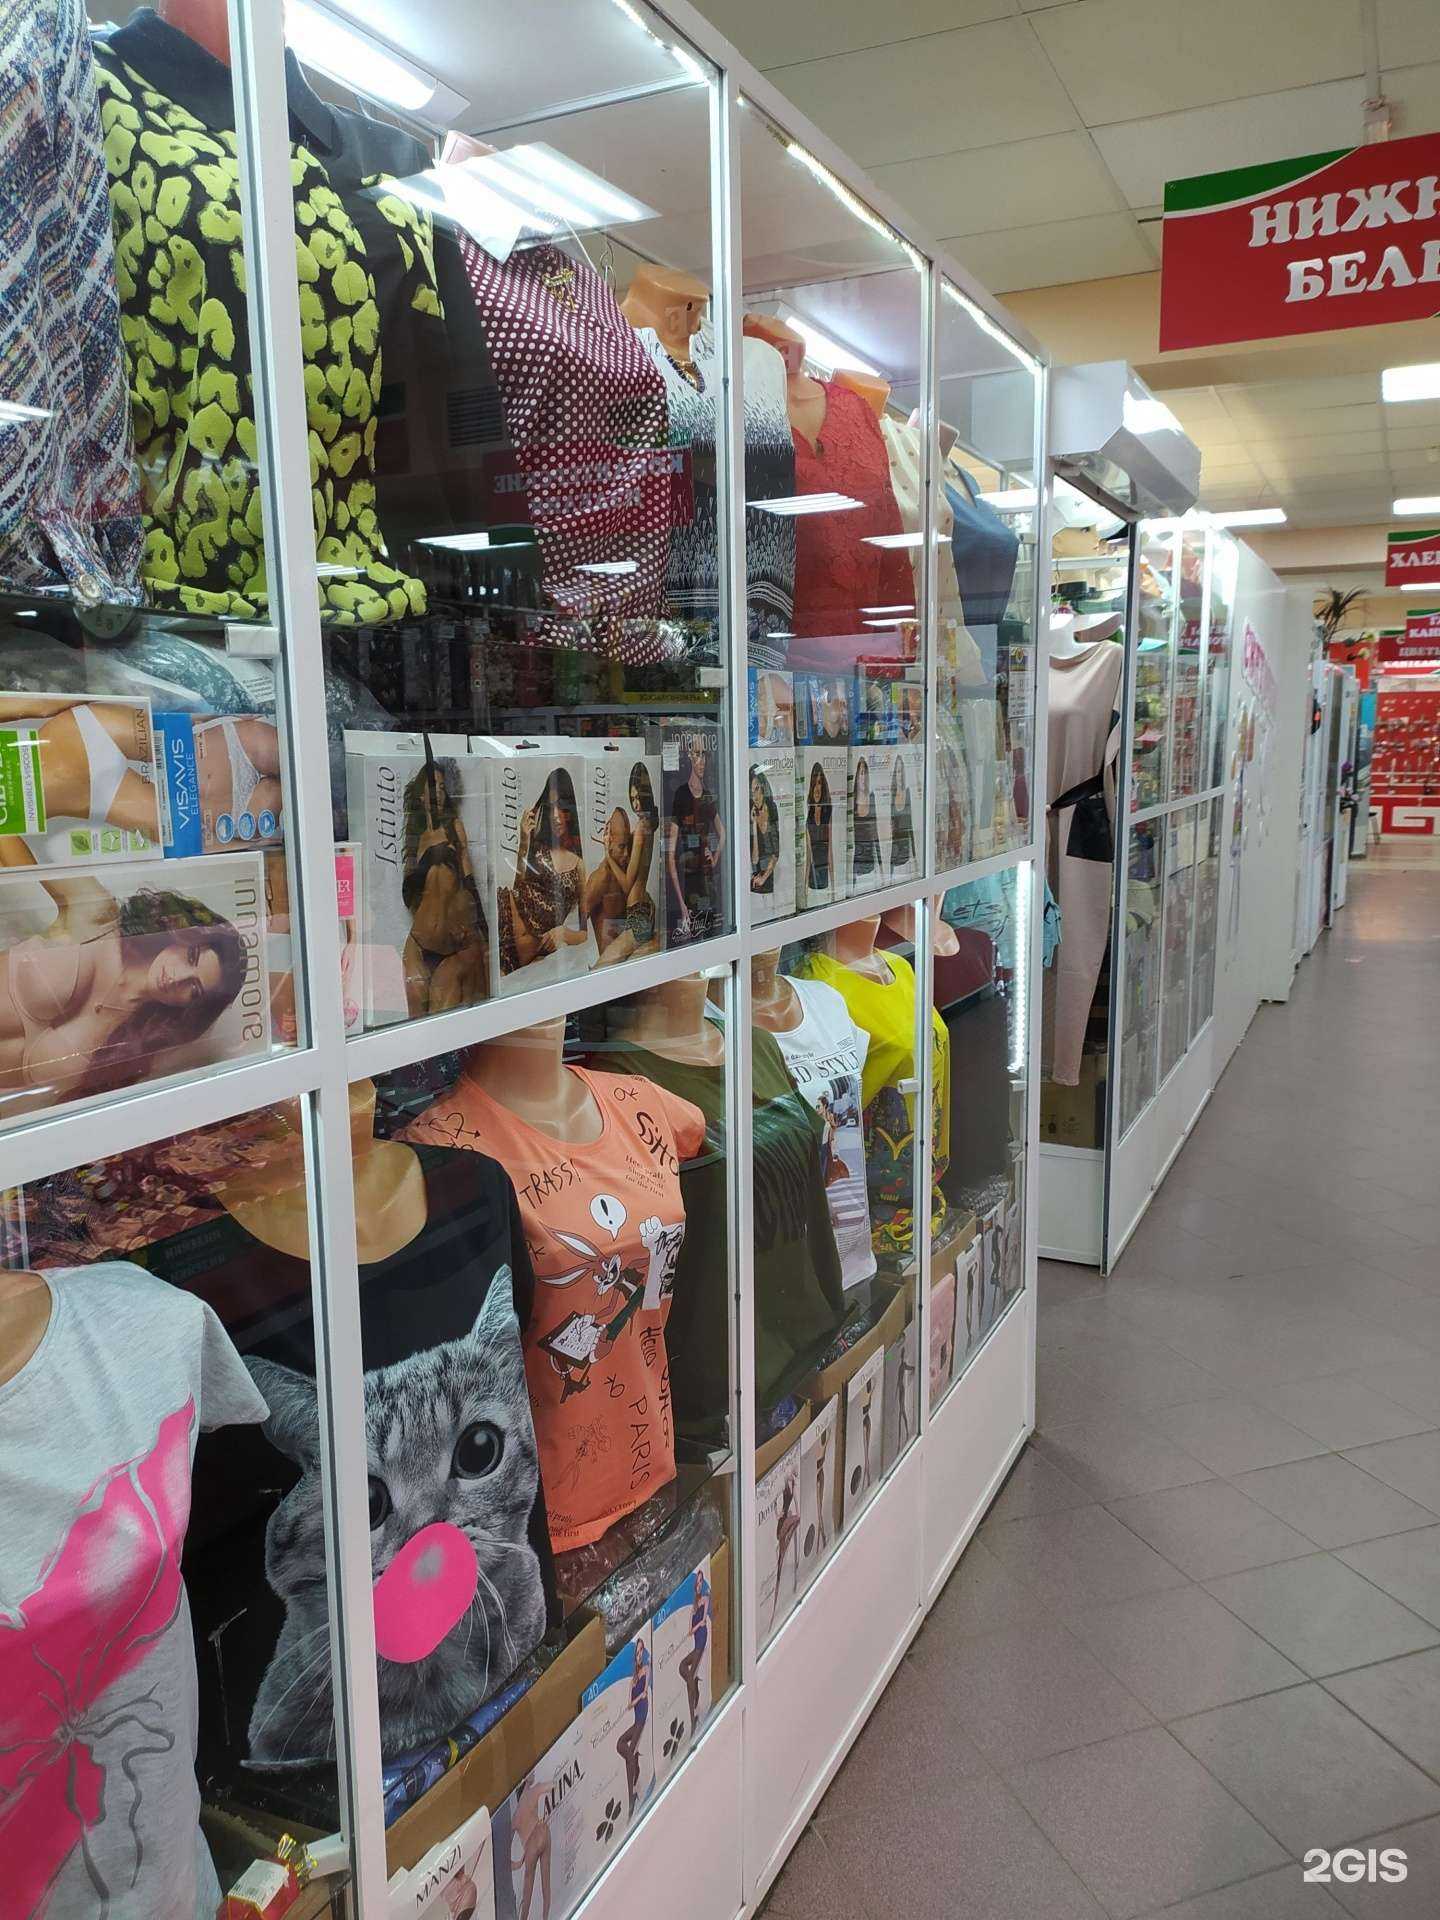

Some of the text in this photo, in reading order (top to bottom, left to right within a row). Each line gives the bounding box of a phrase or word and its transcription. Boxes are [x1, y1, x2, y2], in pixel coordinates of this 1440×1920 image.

[1390, 550, 1440, 568] ХЛЕ
[172, 738, 190, 830] VISAVIS
[186, 753, 198, 815] ELEGANCE
[628, 1394, 651, 1490] PARIS
[543, 1759, 586, 1816] ALINA
